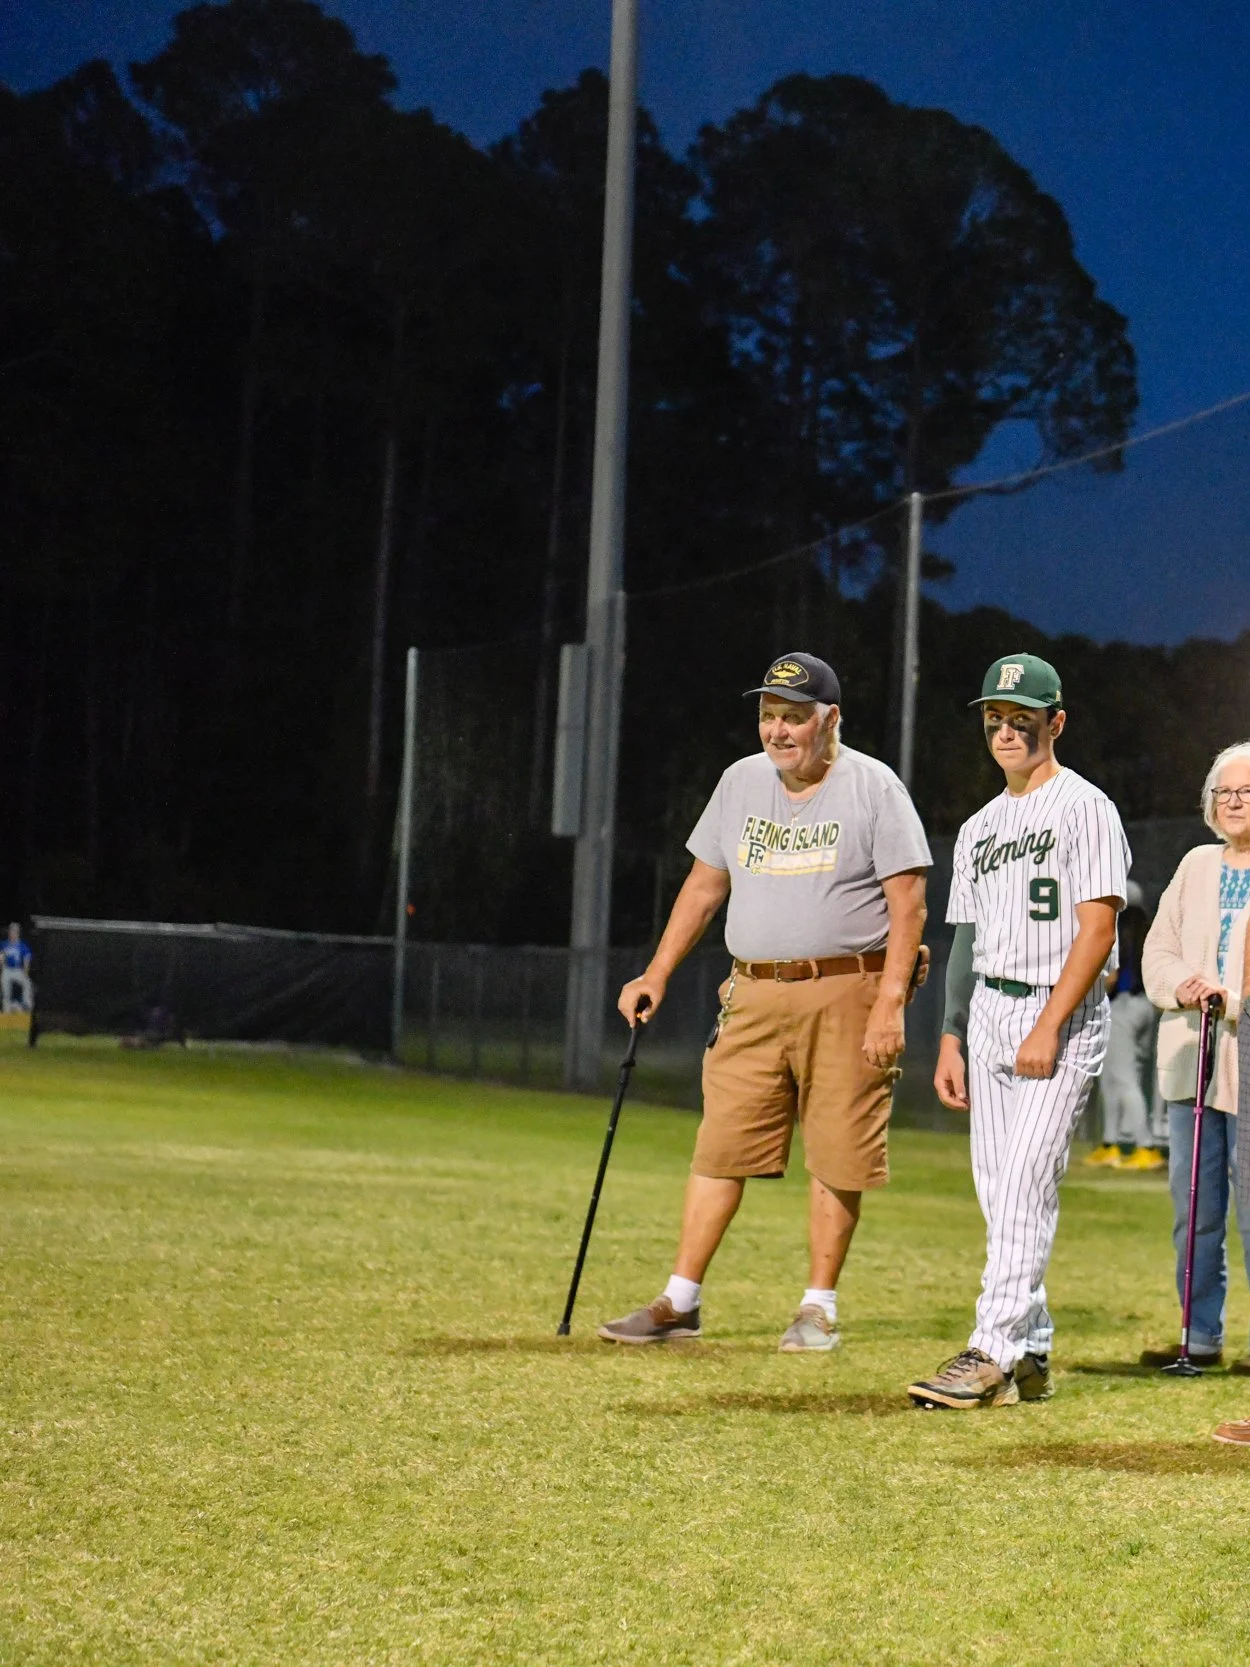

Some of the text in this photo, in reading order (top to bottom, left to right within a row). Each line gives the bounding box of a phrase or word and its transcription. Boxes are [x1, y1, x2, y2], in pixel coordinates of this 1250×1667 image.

[742, 816, 840, 851] FLEMING ISLAND
[971, 826, 1056, 884] Fleming
[1029, 878, 1059, 921] 9
